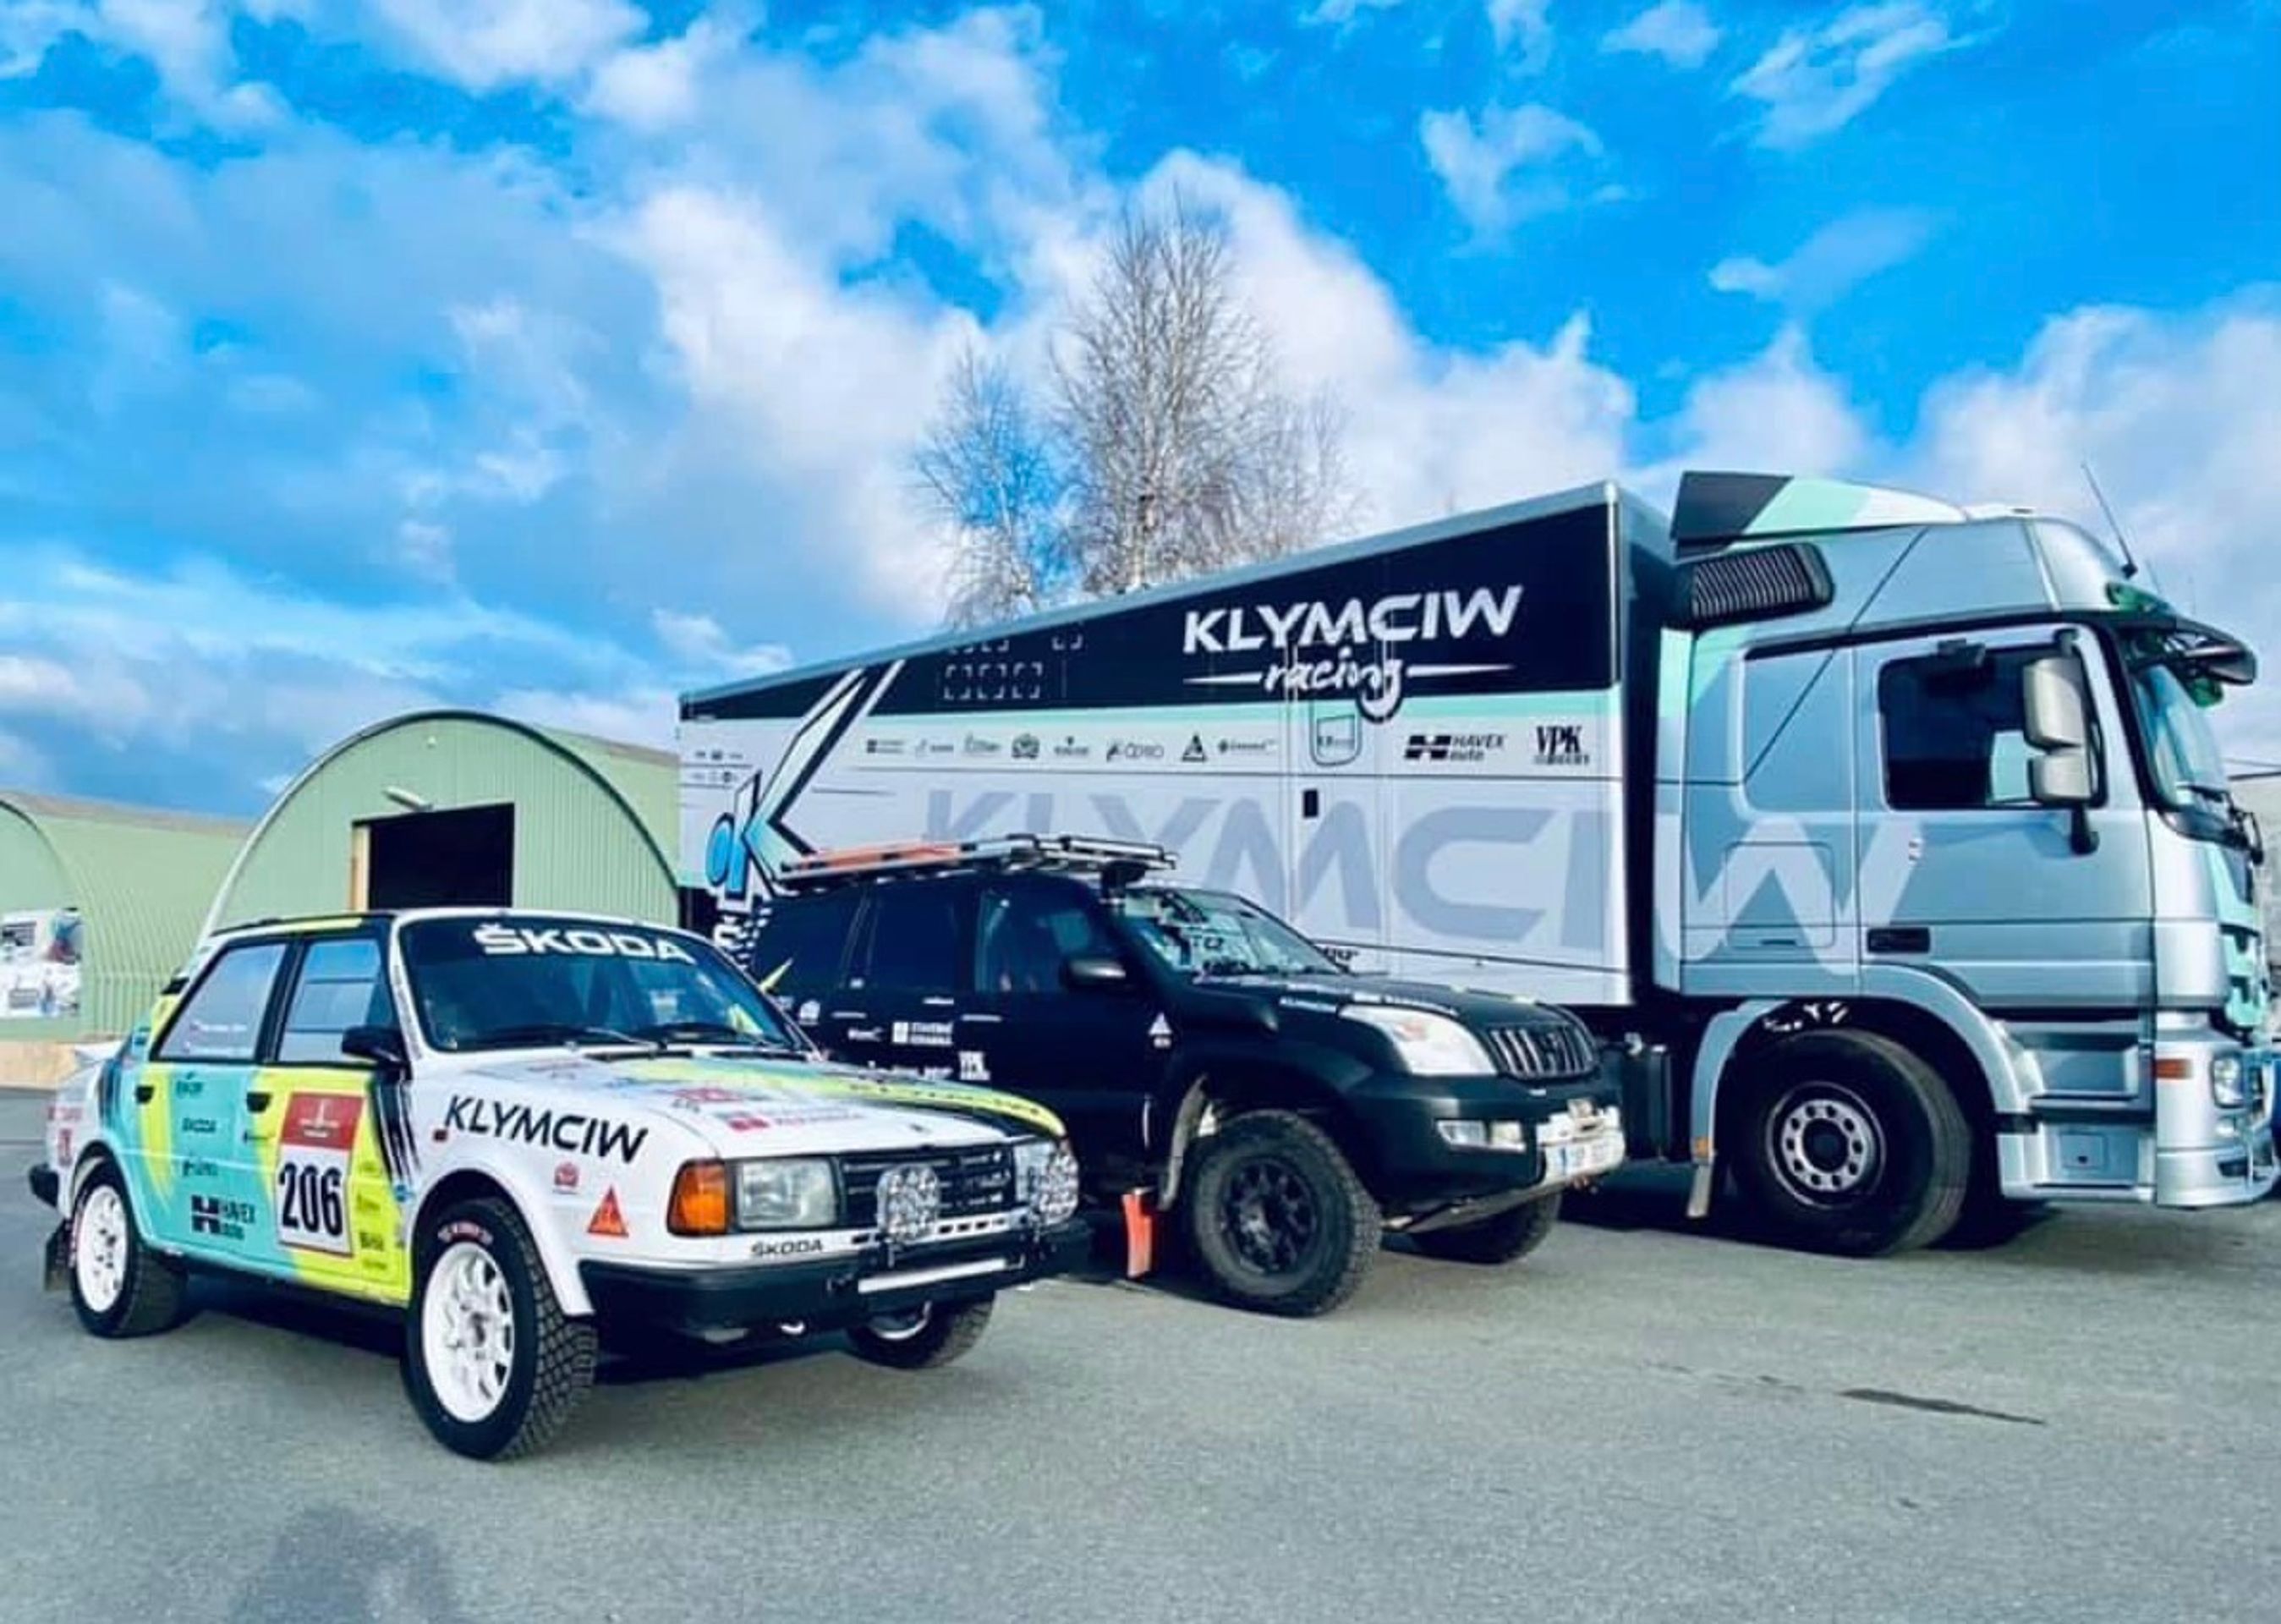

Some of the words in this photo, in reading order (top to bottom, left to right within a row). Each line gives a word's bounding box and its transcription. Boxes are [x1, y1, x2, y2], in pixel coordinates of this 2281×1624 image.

[1183, 586, 1523, 653] KLYMCIW
[1264, 647, 1403, 719] racing
[1537, 726, 1582, 754] VPK
[474, 923, 697, 965] ŠKODA
[444, 1095, 649, 1164] KLYMCIW
[279, 1161, 343, 1237] 206
[751, 1238, 825, 1257] ŠKODA
